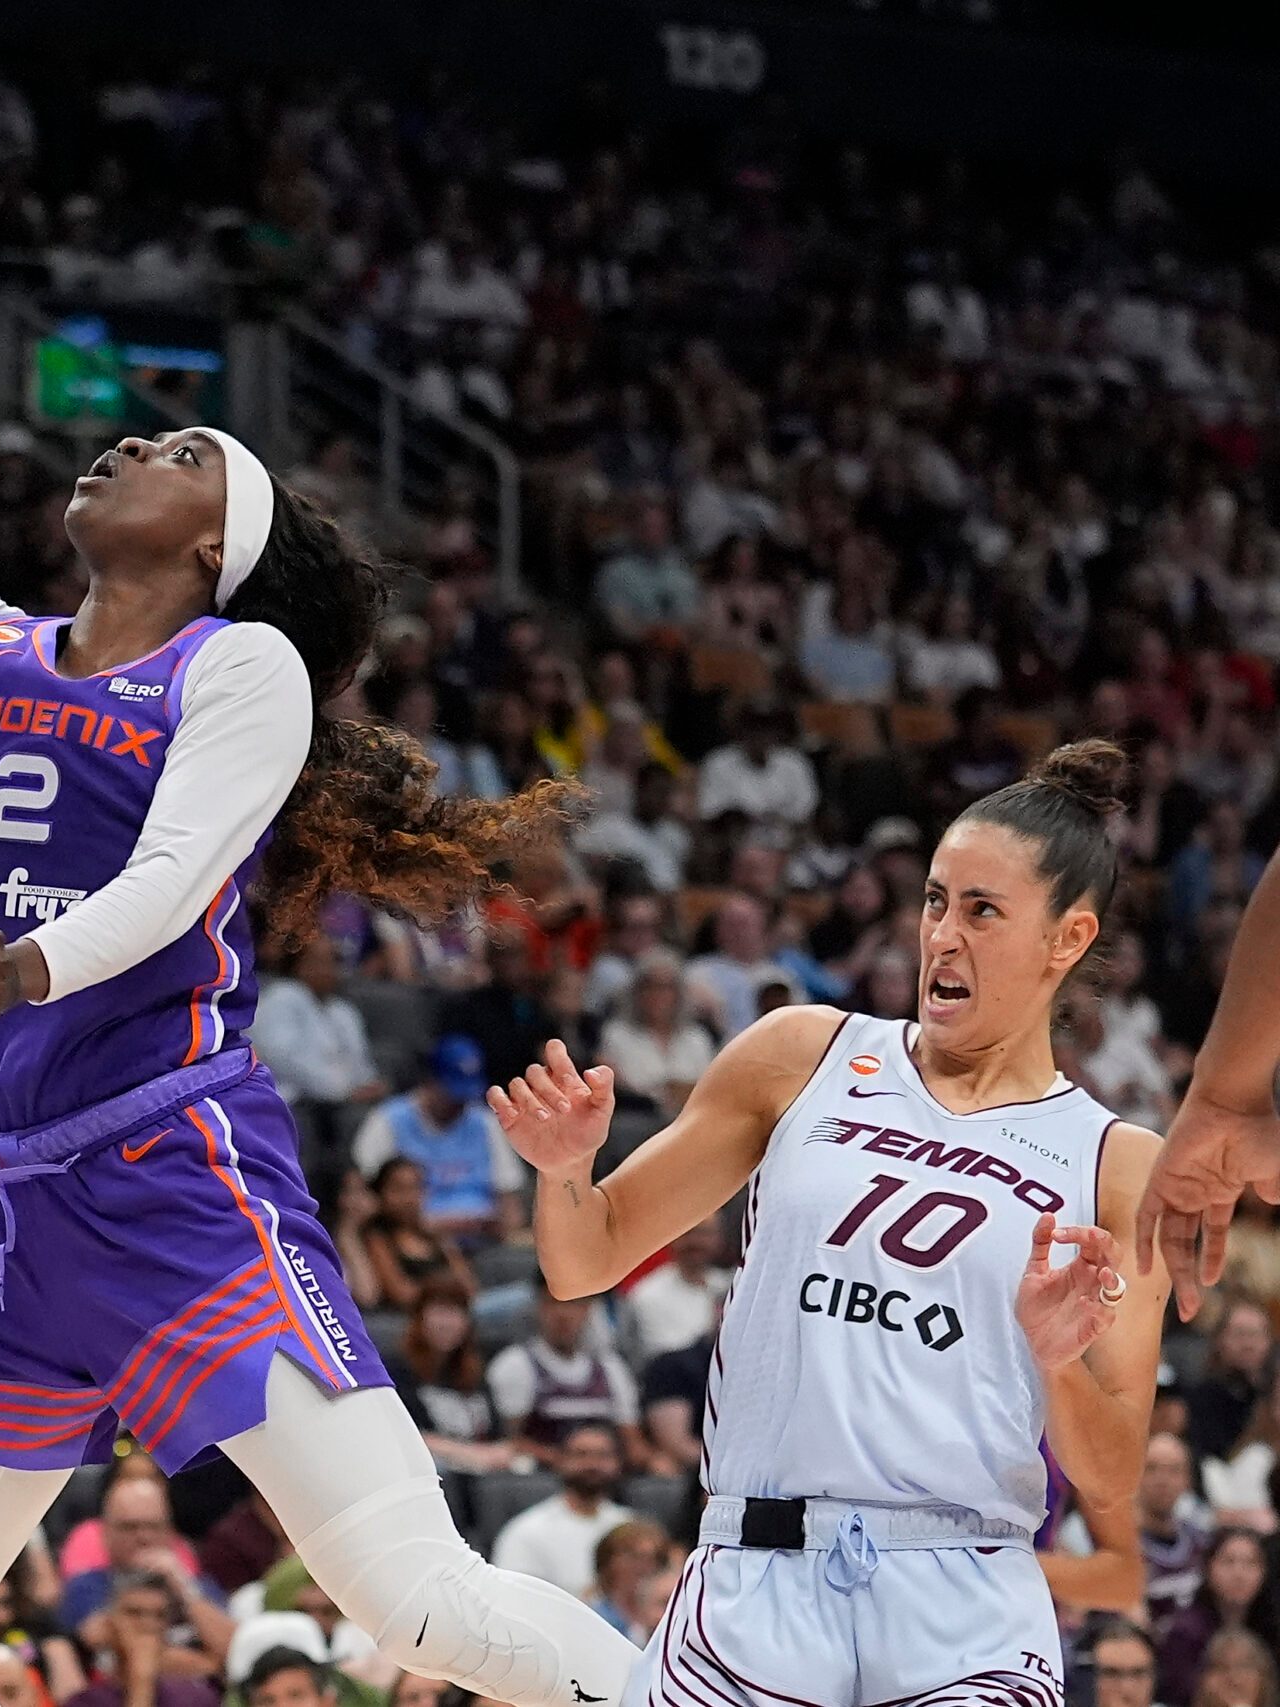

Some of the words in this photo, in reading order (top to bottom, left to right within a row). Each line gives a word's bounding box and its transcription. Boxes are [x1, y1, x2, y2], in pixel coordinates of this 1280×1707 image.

[23, 886, 45, 894] FOOD
[47, 888, 80, 898] STORES
[818, 1116, 1065, 1214] TEMPO
[1001, 1126, 1070, 1169] SEPHORA
[824, 1173, 988, 1268] 10
[282, 1242, 358, 1361] MERCURY
[799, 1273, 912, 1332] CIBC
